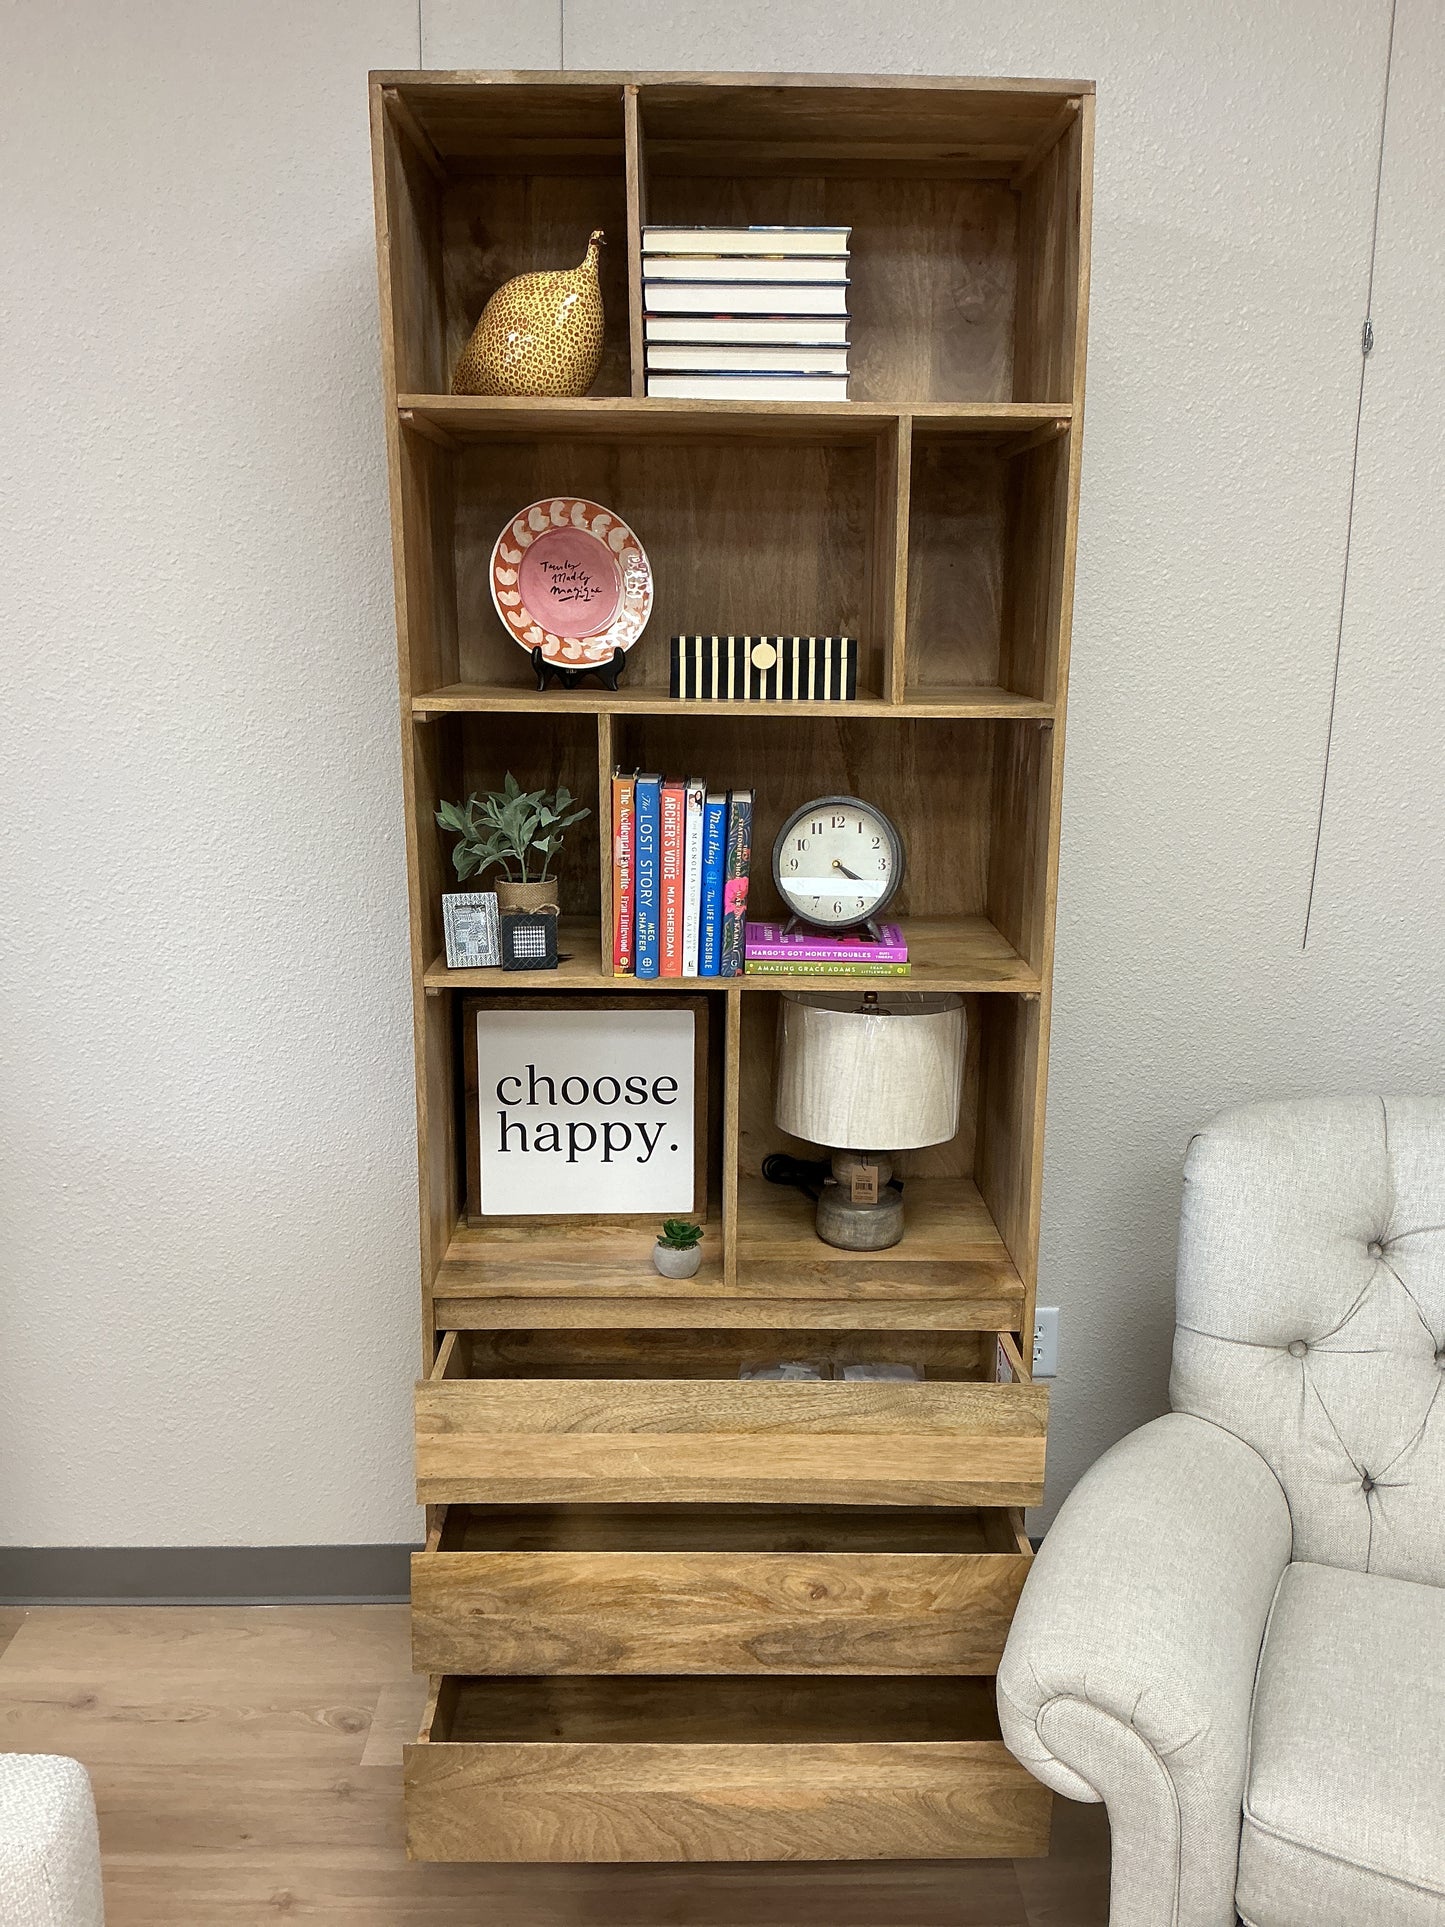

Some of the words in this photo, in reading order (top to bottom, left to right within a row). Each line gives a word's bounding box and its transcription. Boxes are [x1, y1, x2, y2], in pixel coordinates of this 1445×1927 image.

[620, 787, 630, 804] The
[641, 792, 651, 811] The
[621, 808, 631, 852] Accidental
[664, 797, 676, 846] ARCHER'S
[709, 810, 721, 838] Matt
[812, 823, 822, 834] 11
[832, 816, 845, 828] 12
[858, 822, 862, 834] 1
[640, 815, 652, 853] LOST
[872, 837, 880, 849] 2
[705, 840, 720, 865] Haig
[798, 839, 810, 851] 10
[620, 854, 631, 890] Favorite
[664, 850, 675, 880] VOICE
[790, 859, 799, 870] 9
[878, 858, 886, 870] 3
[640, 860, 653, 907] STORY
[667, 886, 675, 904] MIA
[812, 896, 820, 908] 7
[856, 896, 864, 908] 5
[706, 904, 715, 920] LIFE
[834, 902, 842, 913] 6
[620, 915, 629, 952] Littlewood
[638, 912, 647, 951] SHAFFER
[647, 922, 655, 941] MEG
[666, 908, 675, 957] SHERIDAN
[704, 923, 714, 968] IMPOSSIBLE
[496, 1064, 678, 1105] choose
[497, 1111, 678, 1163] happy.
